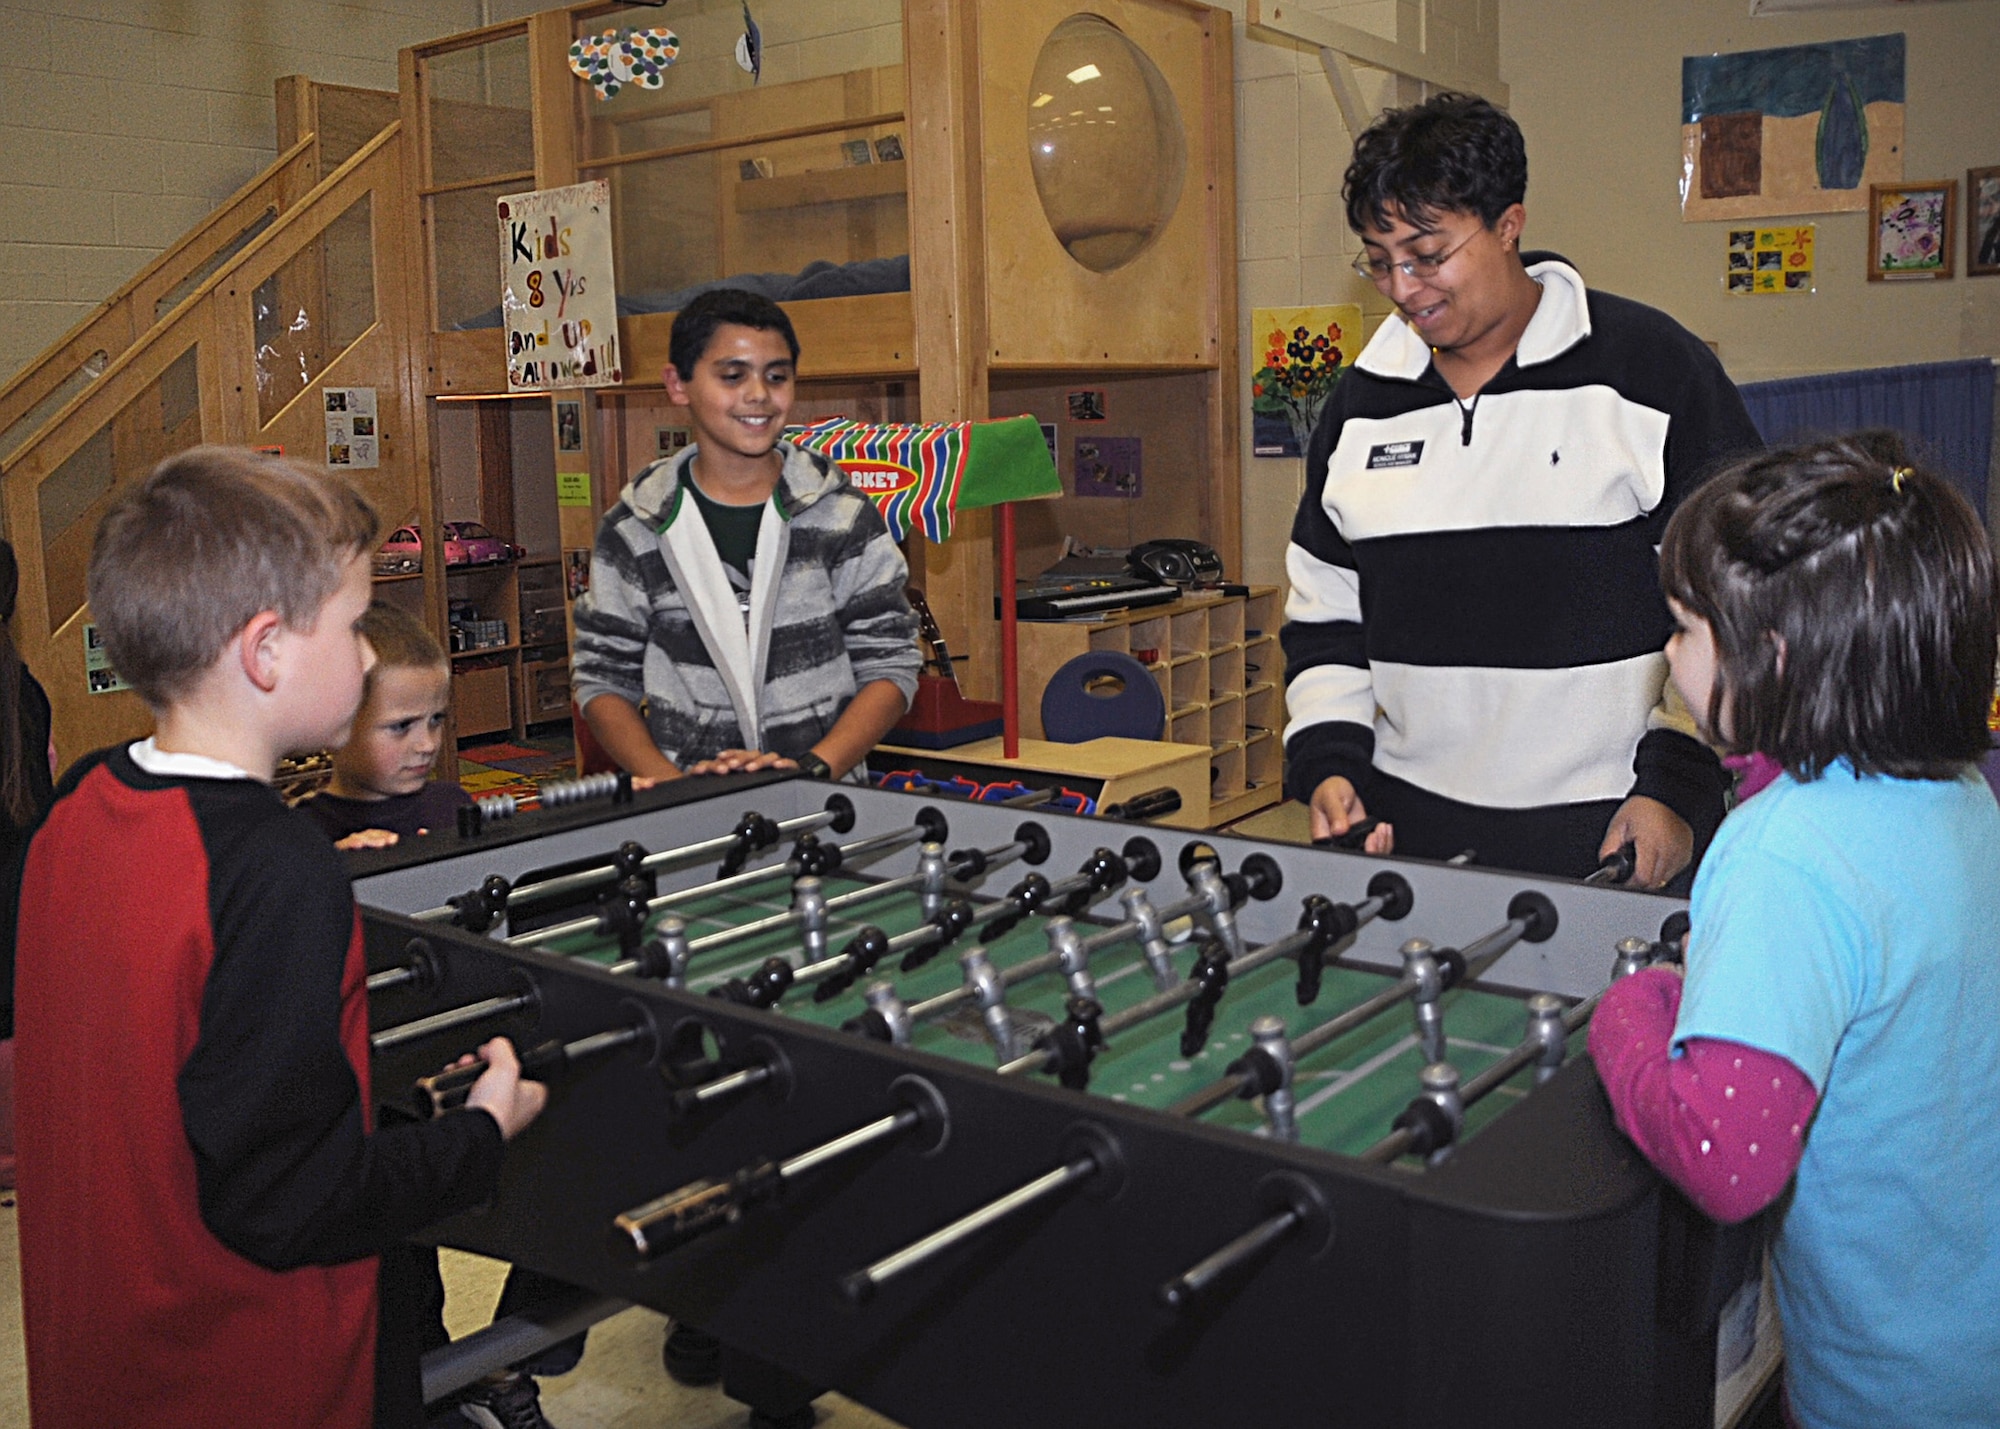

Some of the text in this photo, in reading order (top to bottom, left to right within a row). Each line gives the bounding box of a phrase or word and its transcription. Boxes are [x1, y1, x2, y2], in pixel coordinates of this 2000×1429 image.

[511, 216, 572, 264] Kids
[526, 270, 544, 309] 8
[849, 470, 899, 488] RKET
